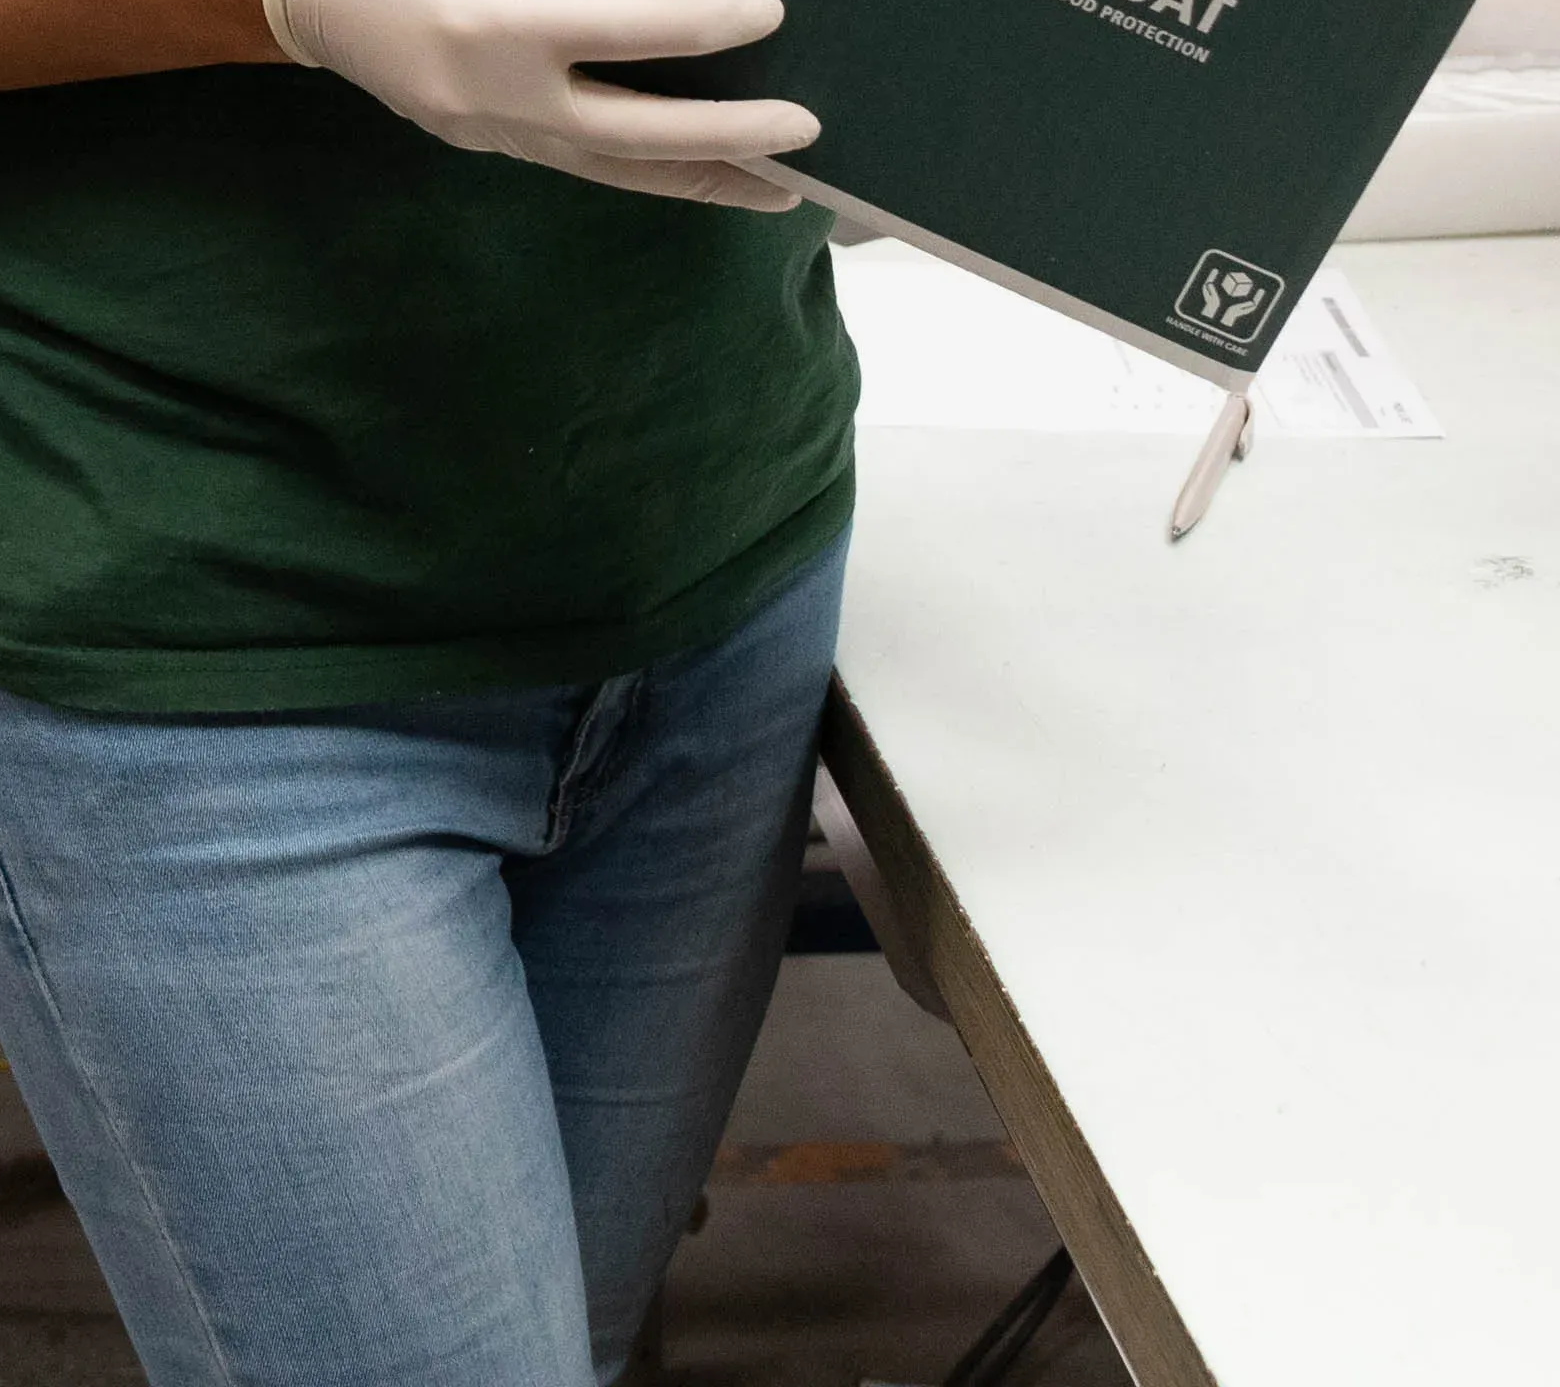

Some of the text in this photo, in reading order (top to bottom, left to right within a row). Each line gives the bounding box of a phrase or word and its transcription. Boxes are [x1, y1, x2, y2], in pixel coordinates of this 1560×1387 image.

[1099, 4, 1211, 65] PROTECTION
[1165, 315, 1250, 358] HANDLE WITH CARE
